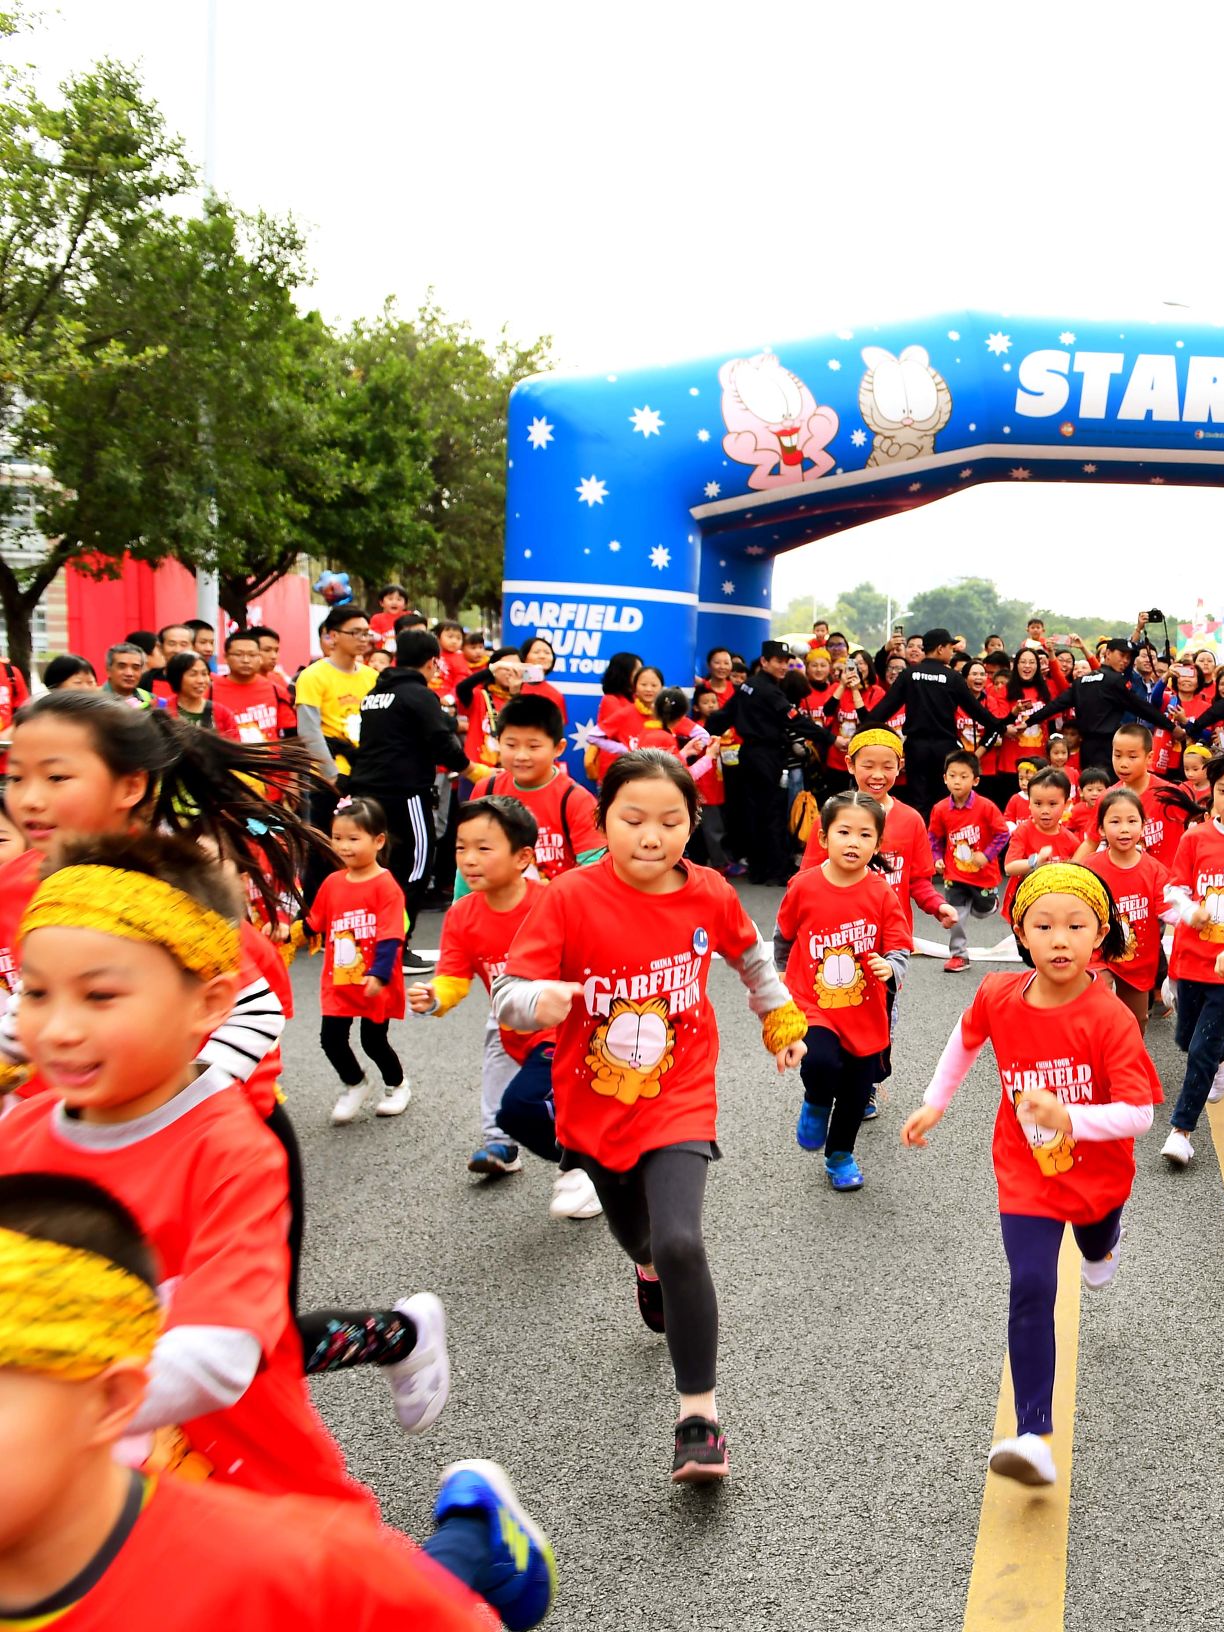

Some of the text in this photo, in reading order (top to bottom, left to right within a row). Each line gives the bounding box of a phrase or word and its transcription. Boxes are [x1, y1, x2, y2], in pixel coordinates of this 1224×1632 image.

[510, 600, 643, 632] GARFIELD
[569, 658, 610, 674] TOU
[361, 693, 395, 711] CREW
[1144, 830, 1163, 847] RUN
[536, 847, 564, 863] RUN
[1129, 907, 1148, 922] RUN
[809, 923, 877, 960] GARFIELD
[650, 951, 692, 971] CHINA TOUR
[584, 957, 701, 1017] GARFIELD
[669, 979, 700, 1015] RUN
[1053, 1058, 1070, 1067] TOUR
[1056, 1082, 1093, 1104] RUN
